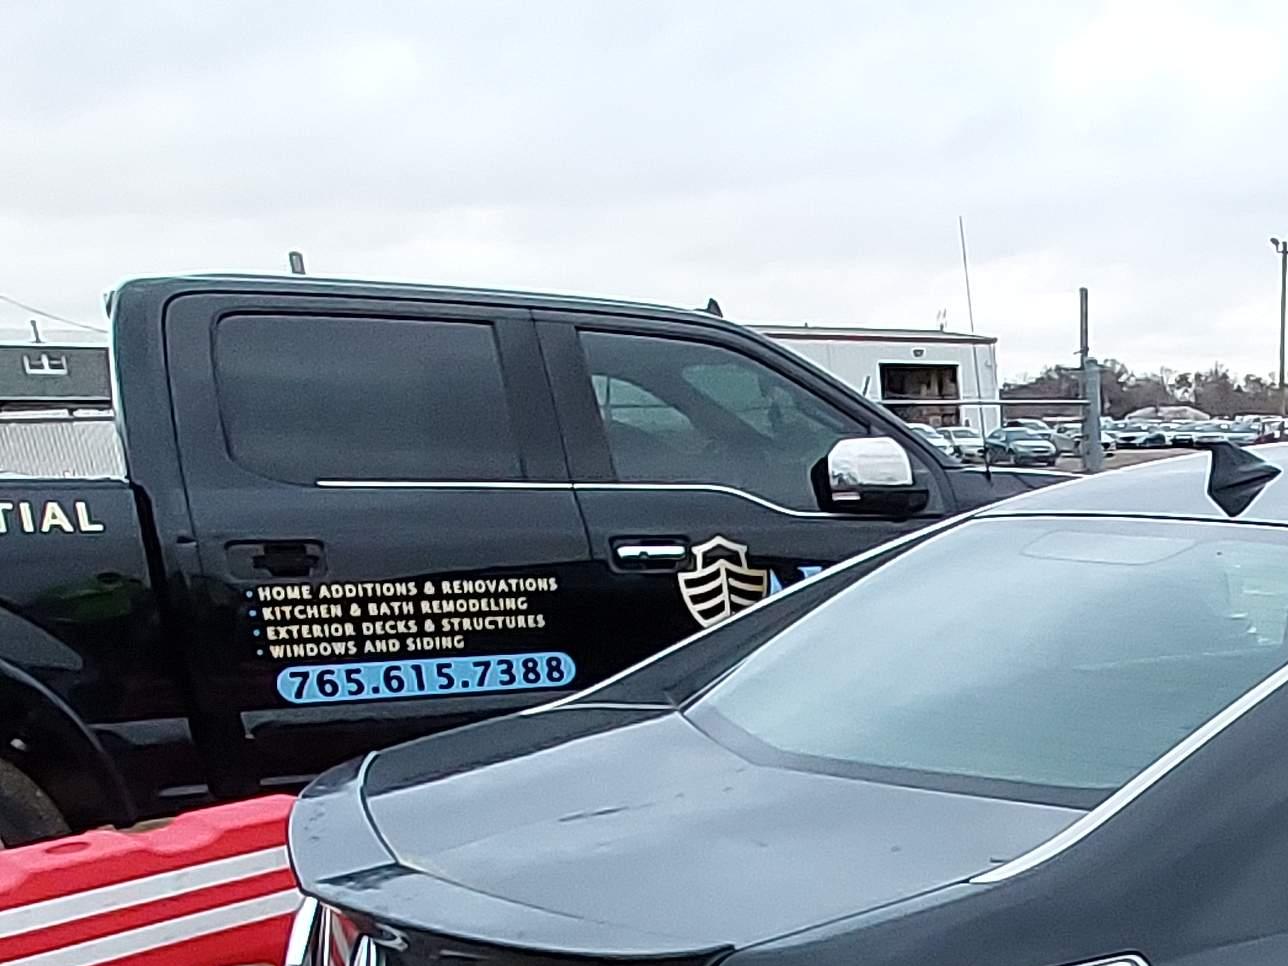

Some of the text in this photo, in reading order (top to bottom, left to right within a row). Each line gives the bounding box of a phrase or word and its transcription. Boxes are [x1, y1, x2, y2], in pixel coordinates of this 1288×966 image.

[257, 577, 559, 601] HOME ADDITIONS & RENOVATIONS
[262, 596, 529, 621] KITCHEN & BATH REMODELING
[266, 614, 546, 640] EXTERIOR DECKS & STRUCTURES
[269, 634, 466, 659] WINDOWS AND SIDING
[288, 656, 565, 700] 765.615.7388
